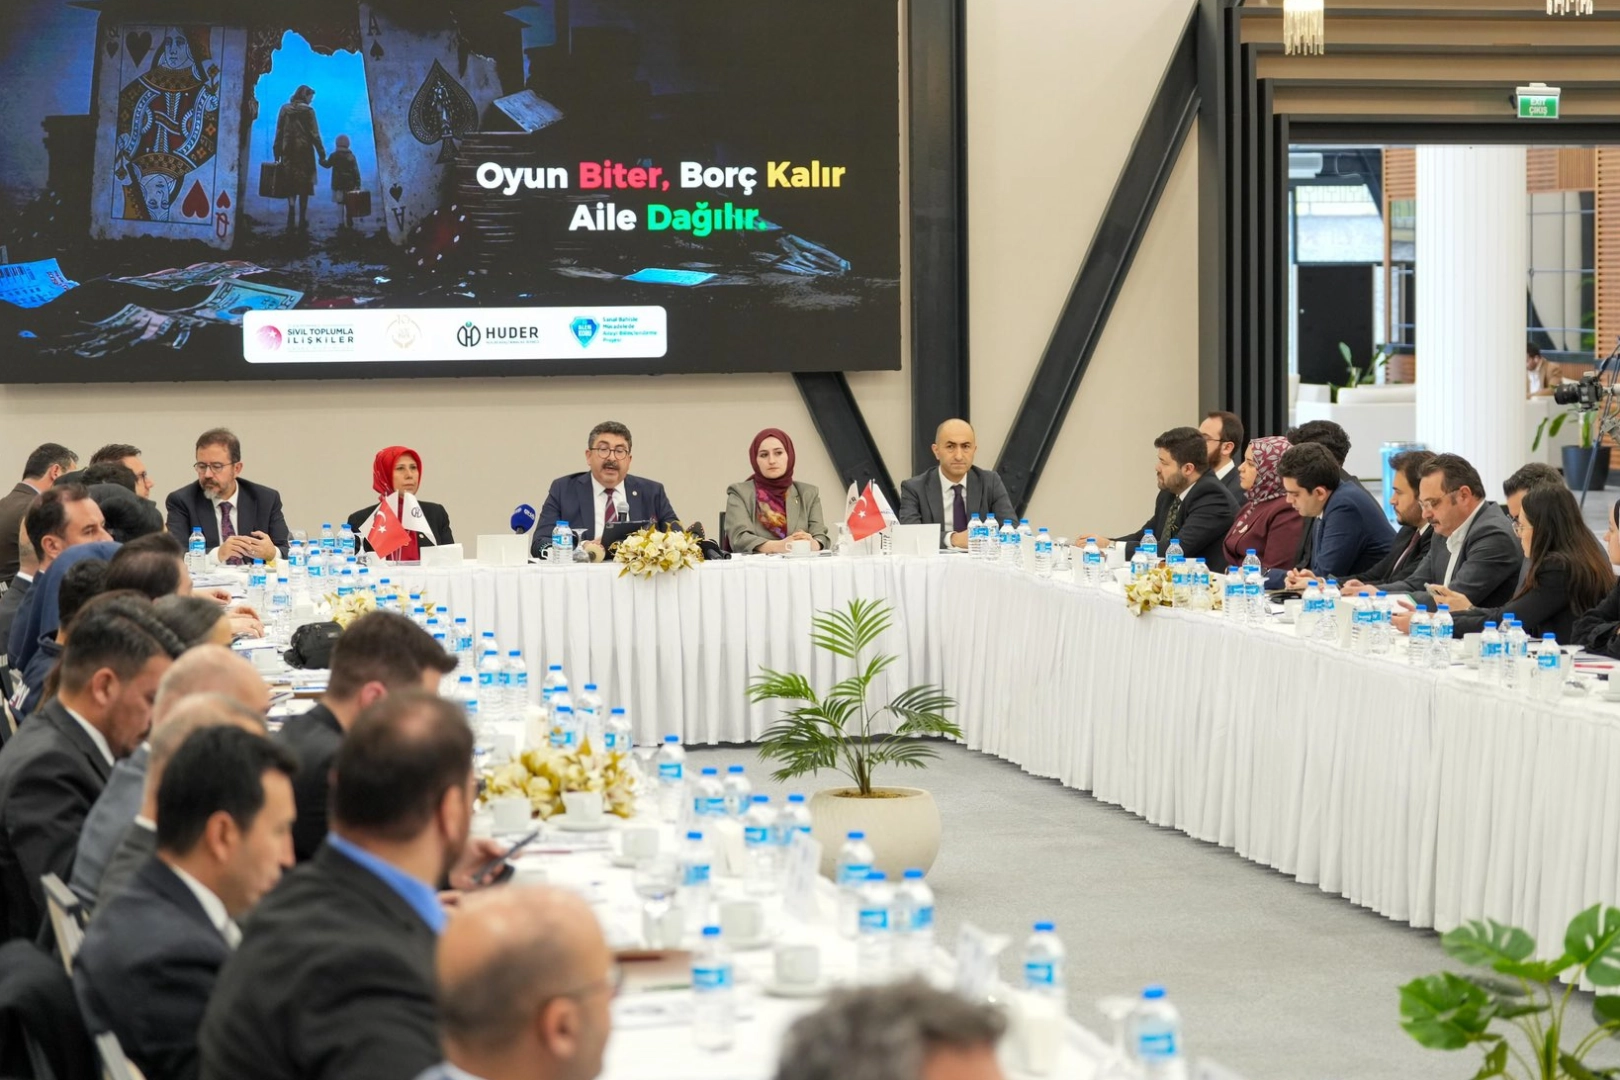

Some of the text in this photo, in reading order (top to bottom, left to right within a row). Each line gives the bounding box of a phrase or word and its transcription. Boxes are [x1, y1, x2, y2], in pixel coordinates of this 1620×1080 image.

[475, 159, 845, 195] Oyun Biter, Borç Kalır
[568, 202, 767, 236] Aile Dağılır.
[309, 328, 354, 336] TOPLUMLA
[486, 326, 539, 339] HUDER
[287, 336, 354, 345] İLİŞKİLER
